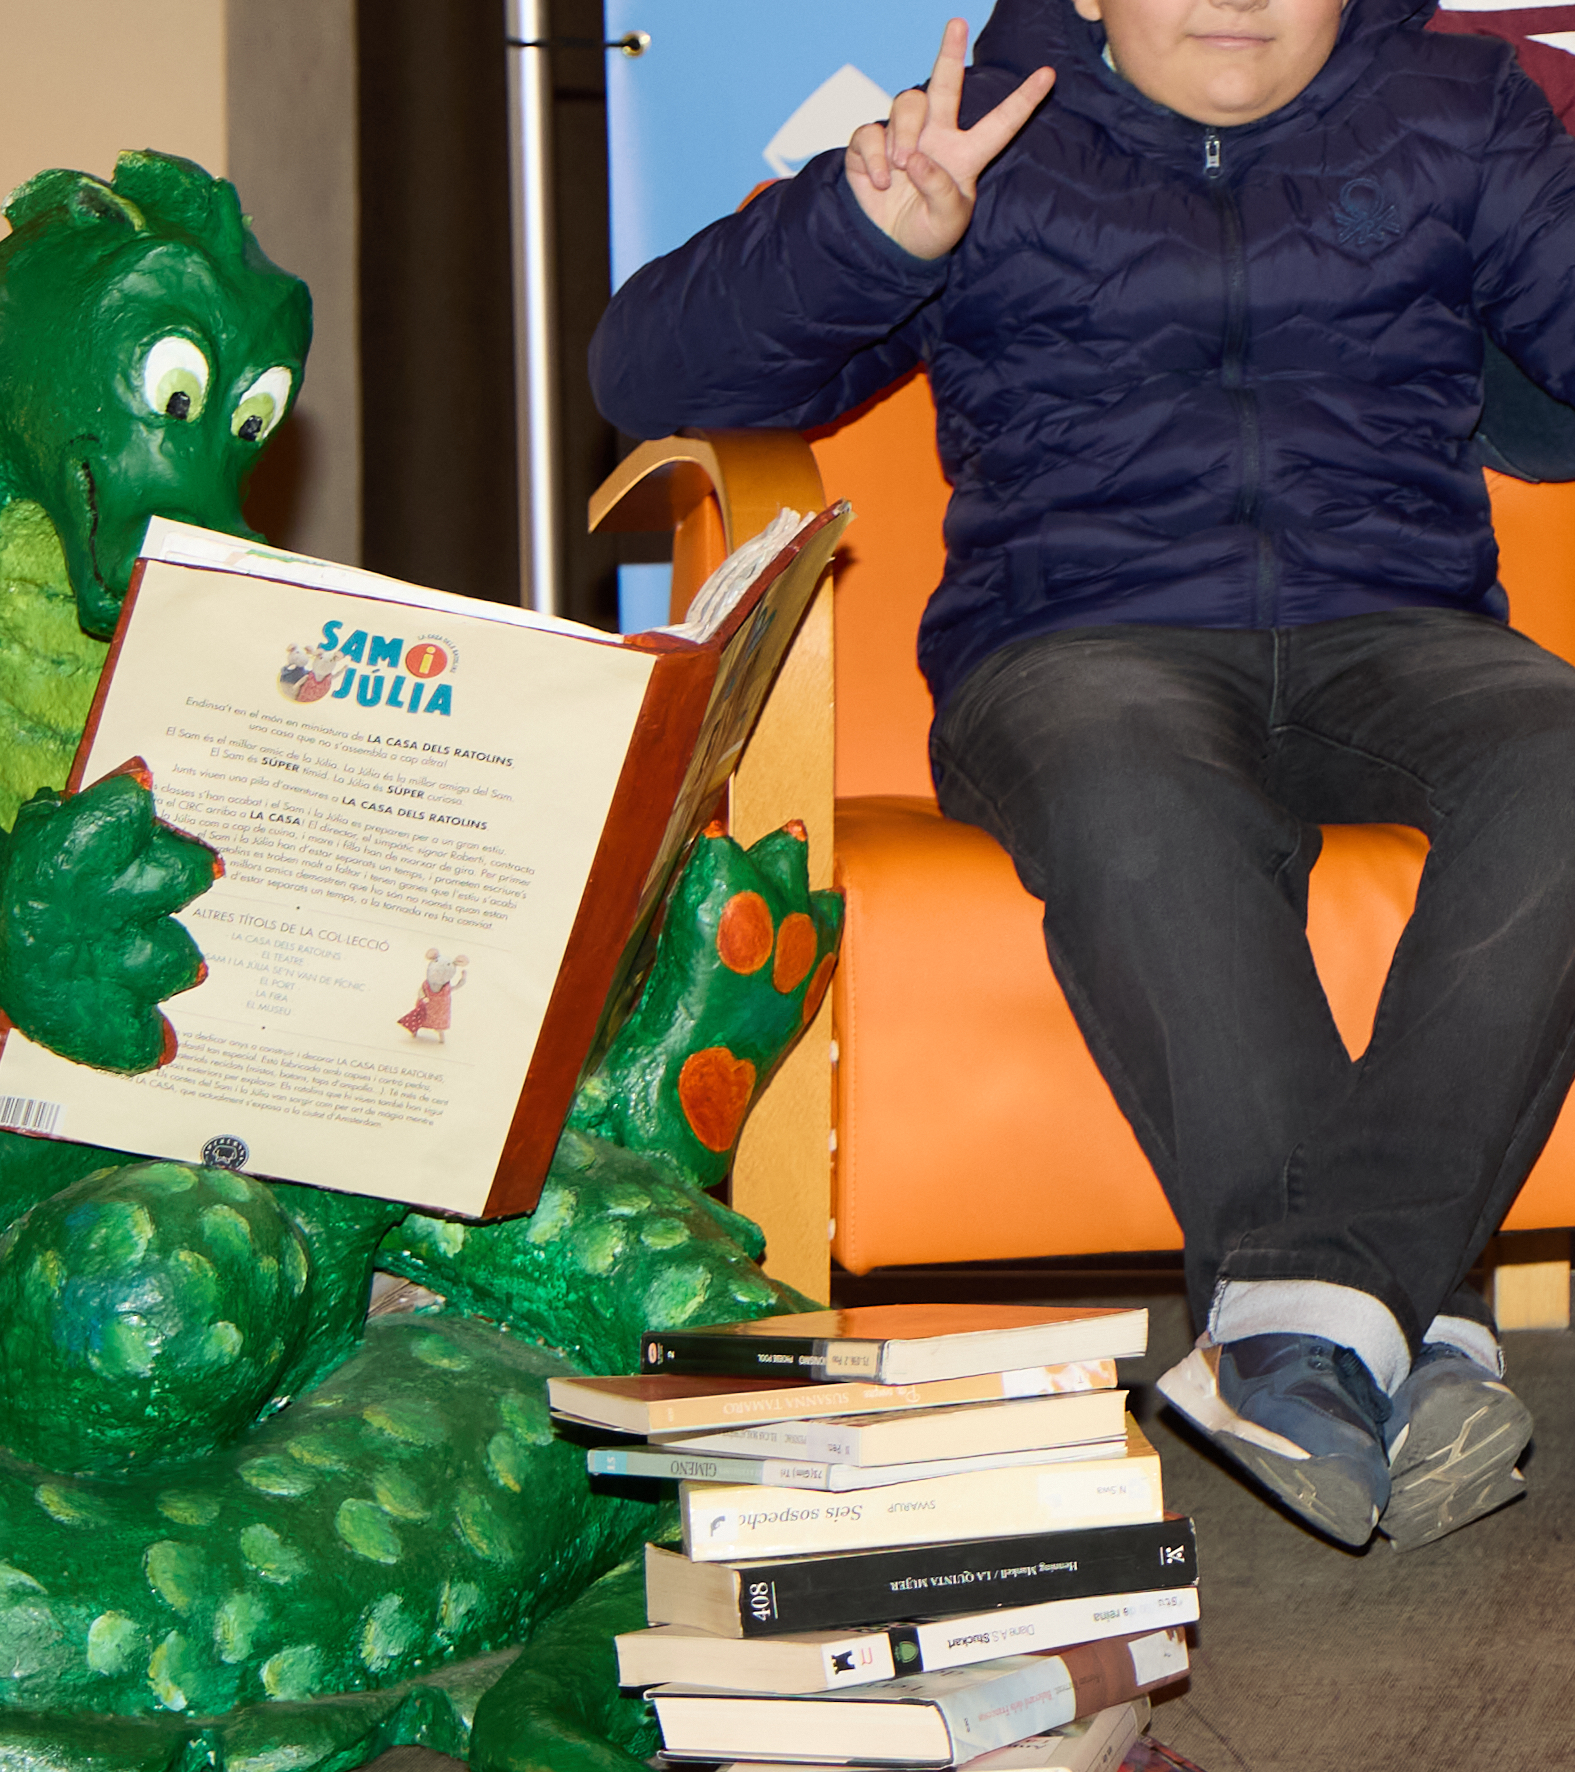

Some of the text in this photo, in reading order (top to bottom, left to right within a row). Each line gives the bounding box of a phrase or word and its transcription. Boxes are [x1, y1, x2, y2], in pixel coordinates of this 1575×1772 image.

[318, 620, 404, 668] SAM
[331, 667, 453, 717] JÚLIA
[233, 708, 246, 716] en
[286, 719, 298, 727] en
[301, 721, 348, 737] miniatura
[351, 731, 364, 741] de
[367, 733, 381, 744] LA
[386, 737, 417, 749] CASA
[423, 742, 449, 755] DELS
[262, 755, 299, 771] SÚPER
[387, 783, 424, 799] SÚPER
[341, 796, 356, 806] LA
[361, 801, 393, 813] CASA
[398, 807, 424, 819] DELS
[193, 906, 234, 923] ALTRES
[239, 912, 276, 930] TÍTOLS
[280, 921, 296, 934] DE
[299, 925, 314, 937] LA
[723, 1398, 783, 1415] TAMARO
[786, 1392, 850, 1410] SUSANNA
[671, 1460, 717, 1477] GIMENO
[826, 1504, 863, 1520] Seis
[888, 1499, 936, 1513] SWARUP
[931, 1570, 976, 1587] QUINTA
[978, 1570, 992, 1581] LA
[890, 1577, 929, 1592] MUJER
[750, 1581, 771, 1621] 408
